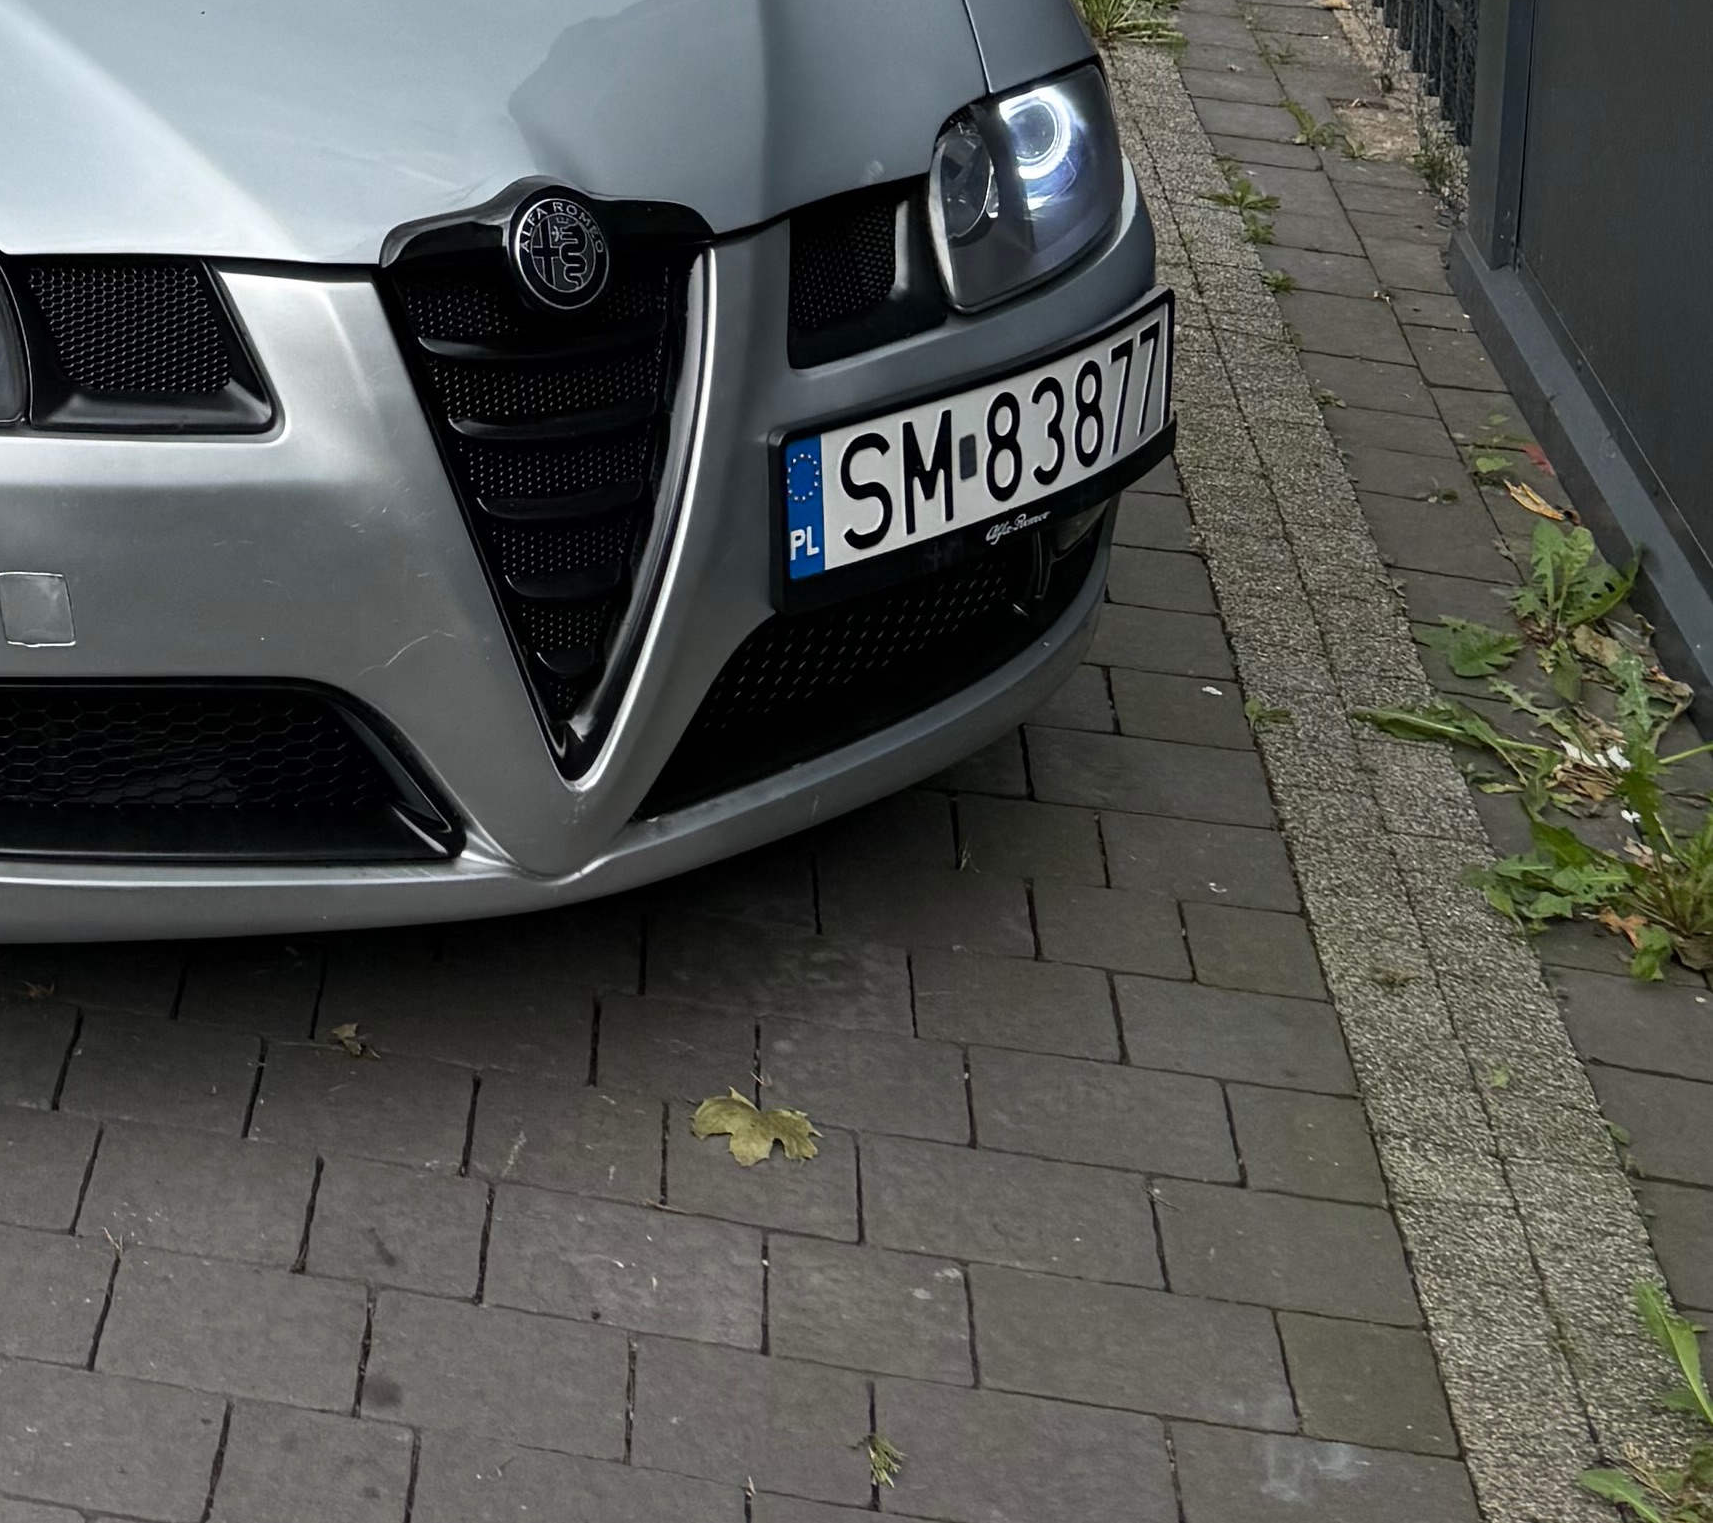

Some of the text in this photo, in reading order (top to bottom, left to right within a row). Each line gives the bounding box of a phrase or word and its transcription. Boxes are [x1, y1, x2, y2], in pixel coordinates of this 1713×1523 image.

[520, 201, 605, 254] ALFA ROMEO
[840, 321, 1161, 550] SM 83877
[789, 526, 820, 561] PL
